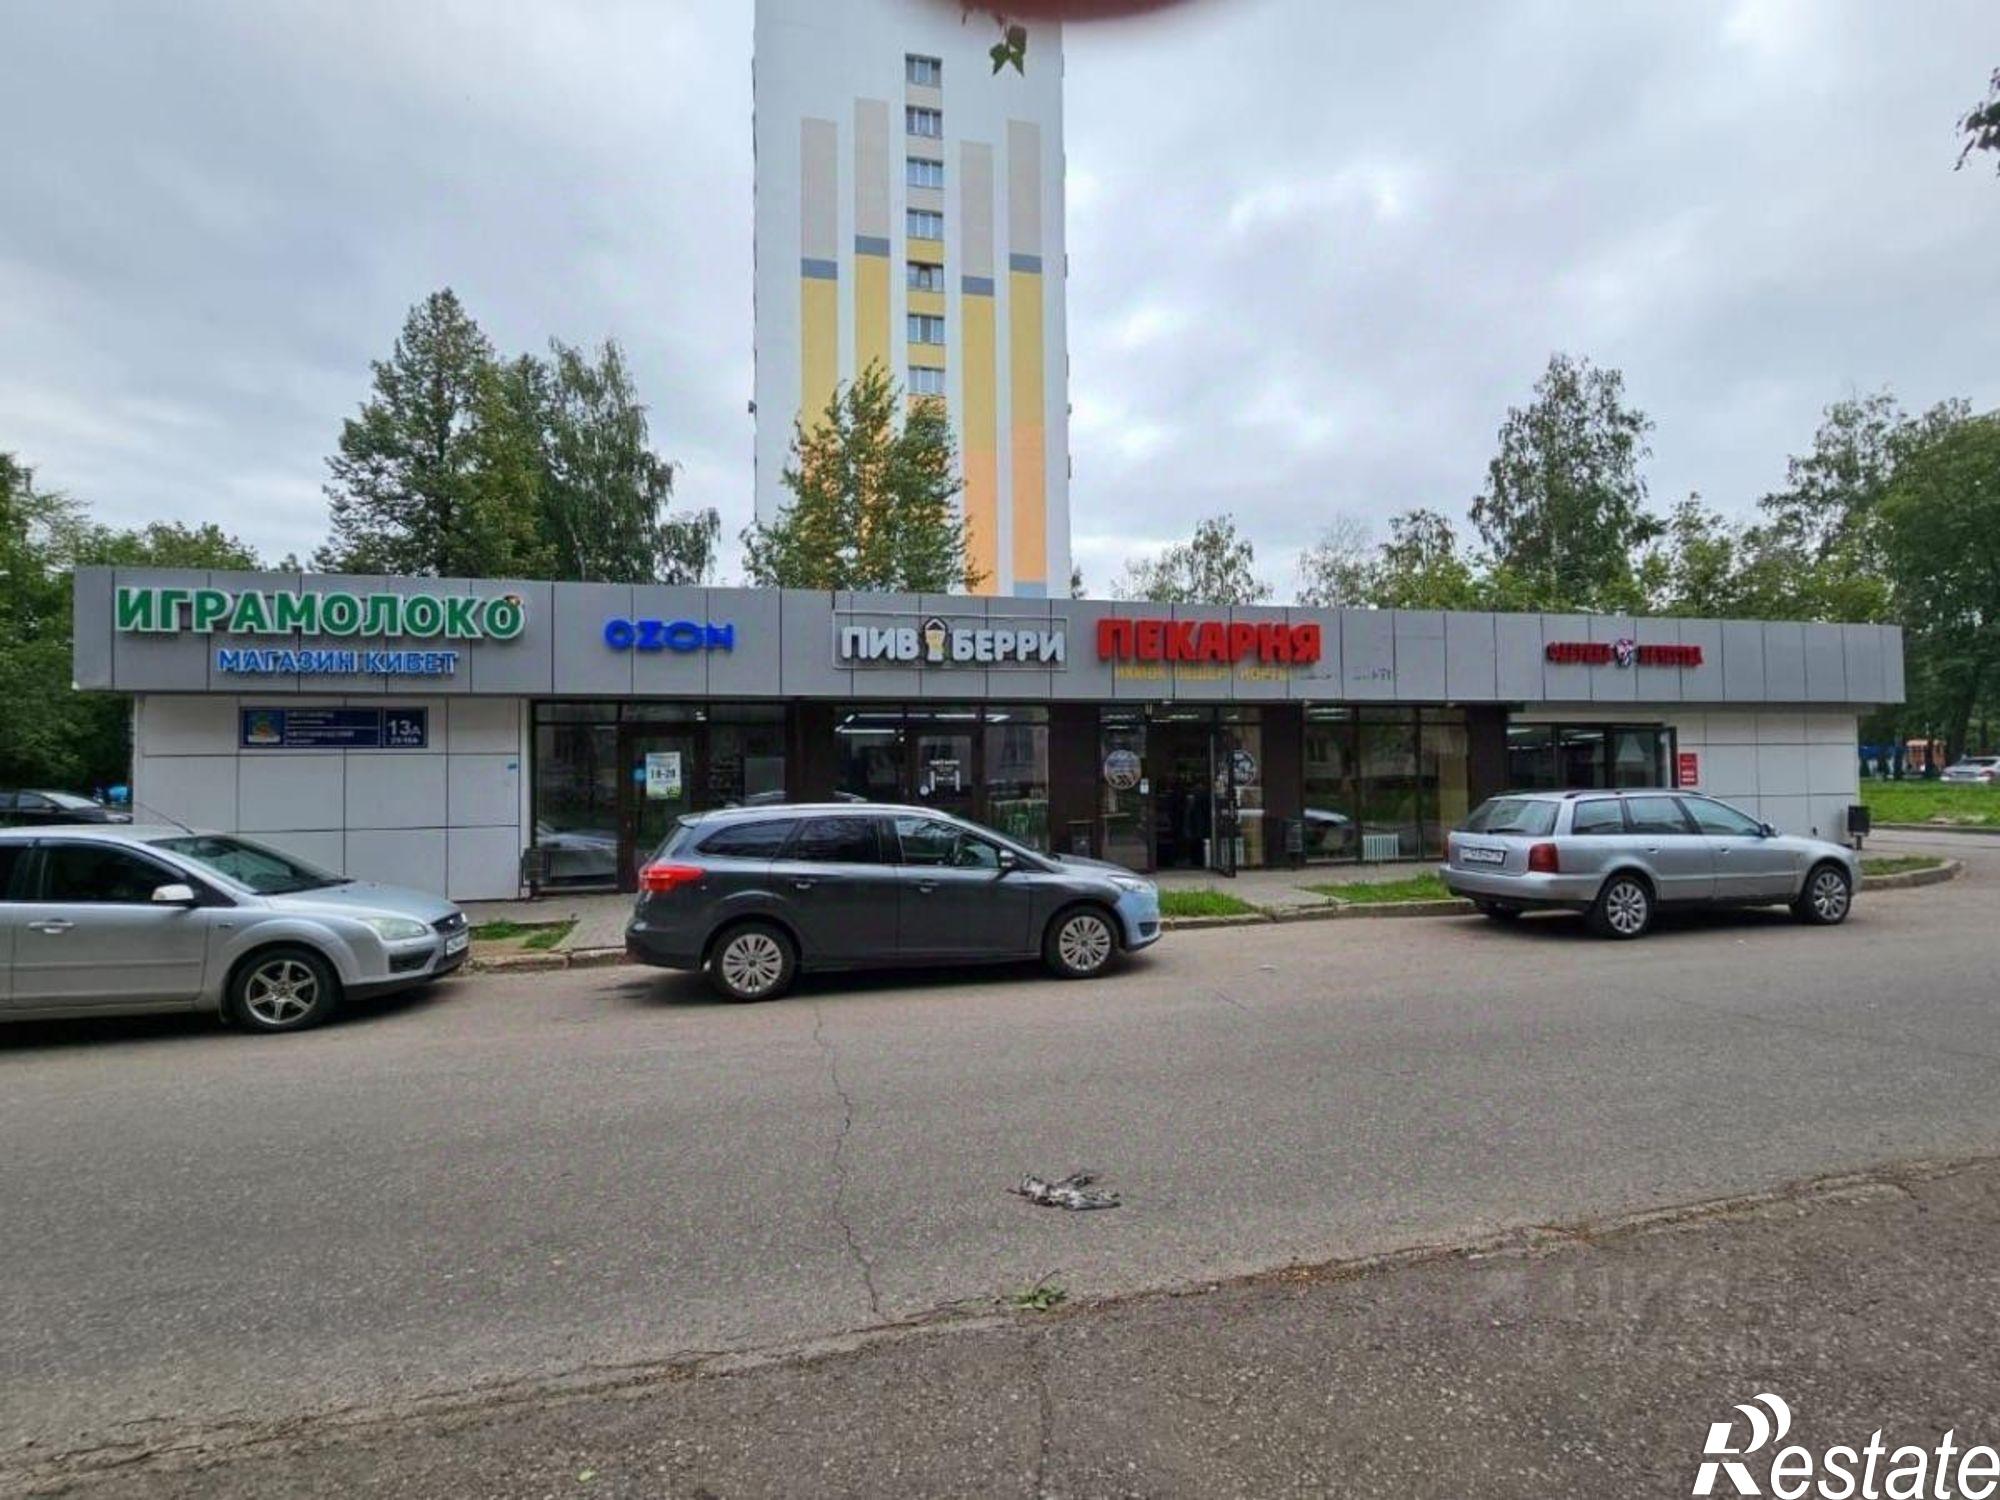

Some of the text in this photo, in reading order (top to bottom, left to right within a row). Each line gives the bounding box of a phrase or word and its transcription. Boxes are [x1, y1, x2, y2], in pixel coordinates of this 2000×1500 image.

[115, 586, 525, 639] ИГРАМОЛОКО
[603, 618, 737, 652] OZON
[841, 625, 1067, 664] ПИВ БЕРРИ
[1097, 618, 1322, 664] ПЕКАРНЯ
[216, 649, 458, 676] МАГАЗИН КИБЕТ
